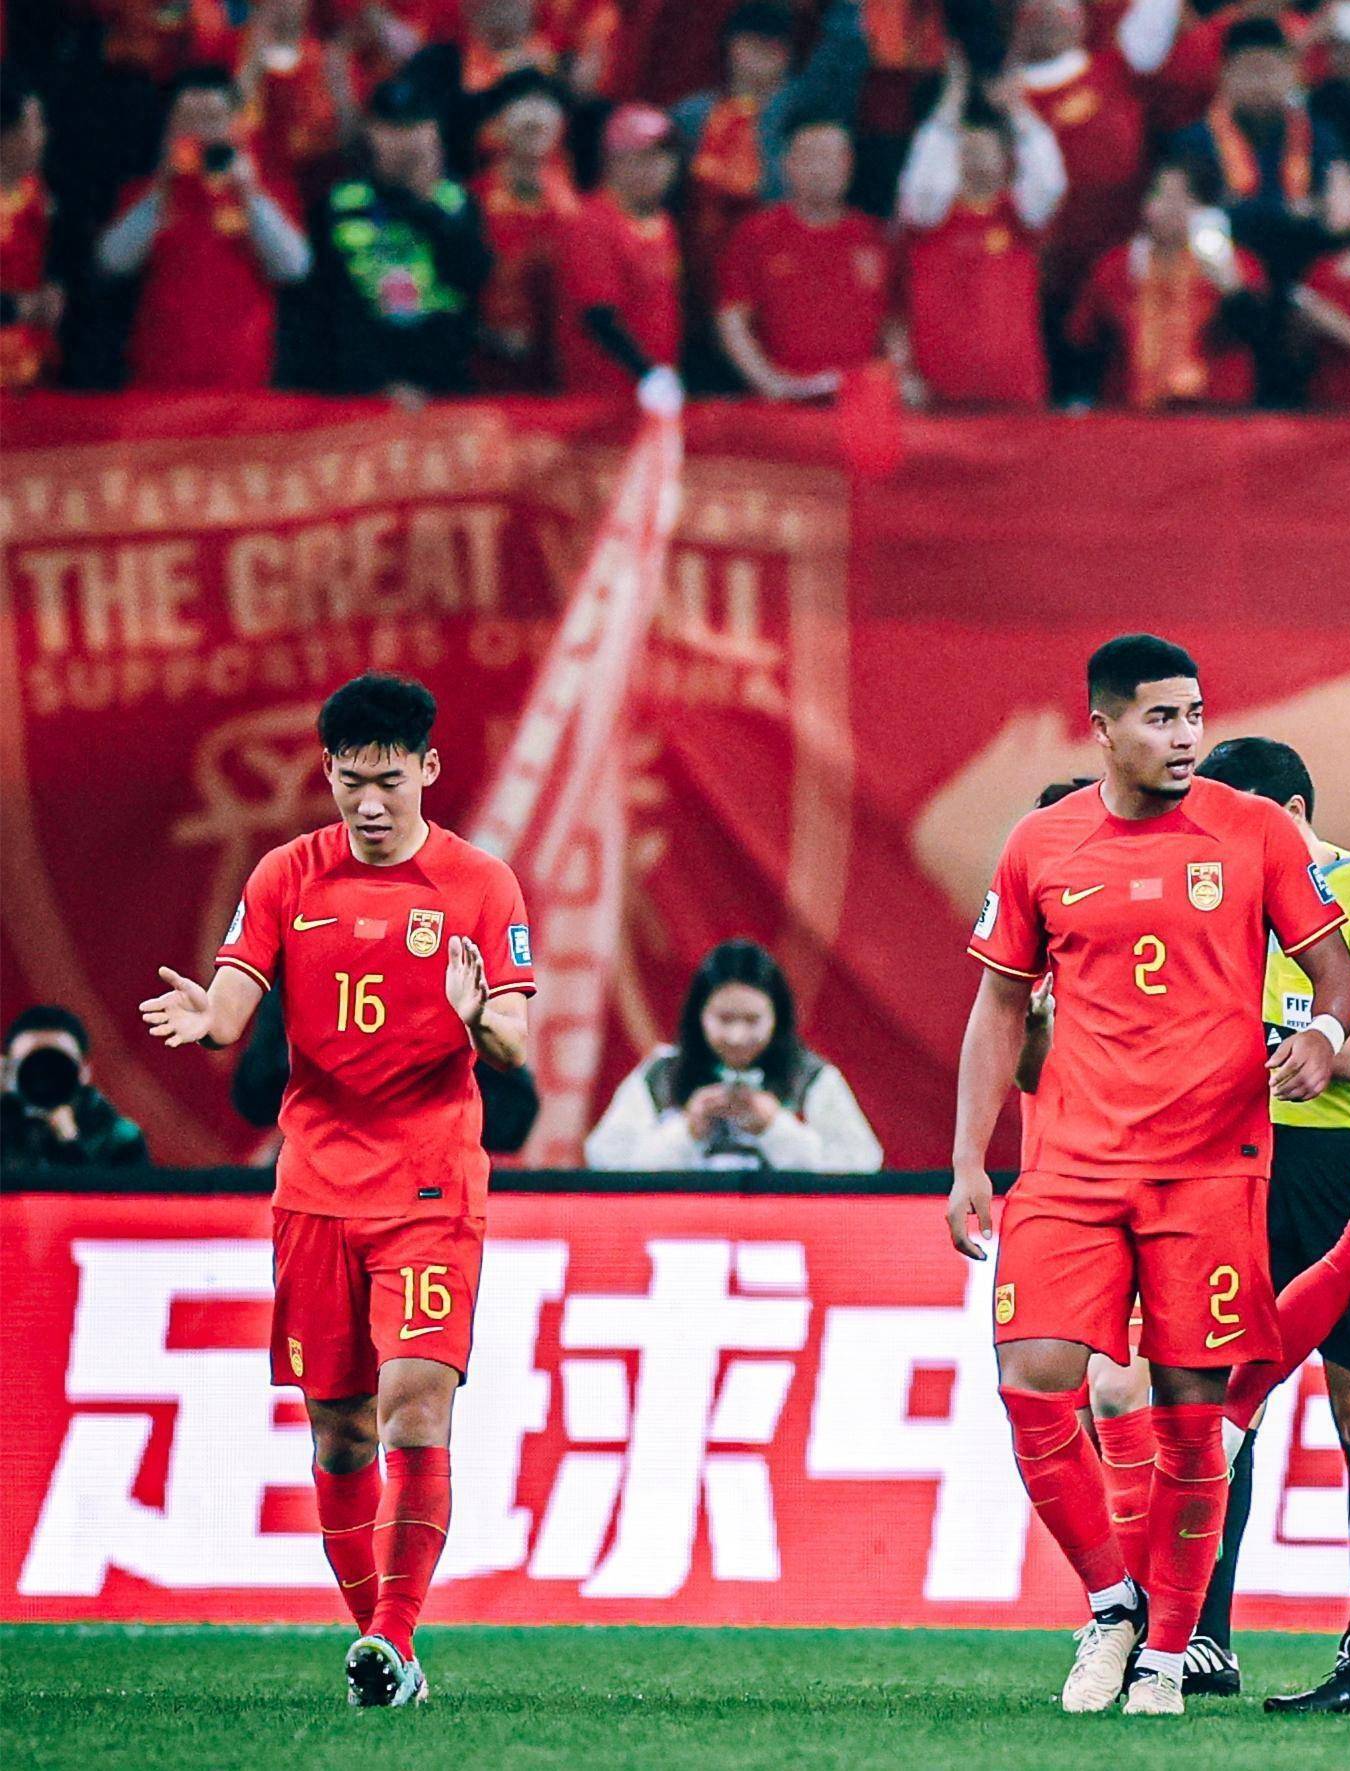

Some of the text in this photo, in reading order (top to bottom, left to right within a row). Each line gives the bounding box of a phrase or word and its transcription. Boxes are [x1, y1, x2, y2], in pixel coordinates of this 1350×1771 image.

[20, 540, 203, 655] THE
[227, 505, 506, 640] GREAT
[1133, 934, 1167, 995] 2
[334, 972, 386, 1033] 16
[1286, 997, 1310, 1011] FIF
[400, 1265, 451, 1320] 16
[1209, 1265, 1240, 1324] 2
